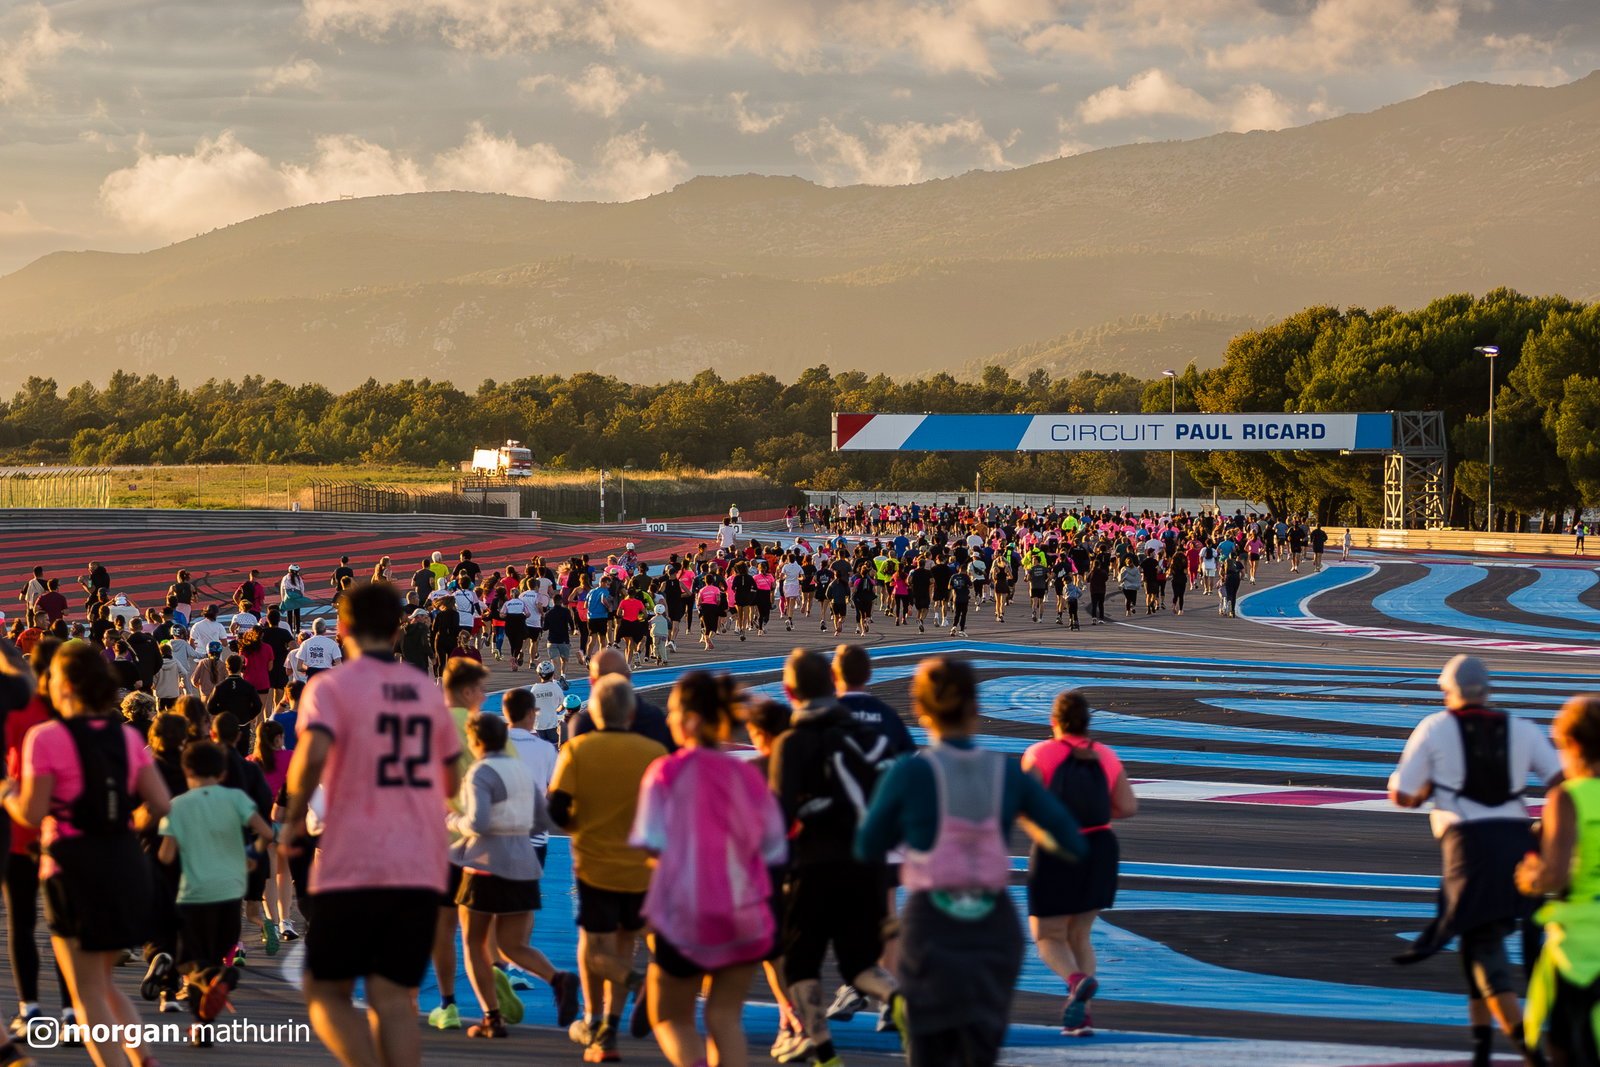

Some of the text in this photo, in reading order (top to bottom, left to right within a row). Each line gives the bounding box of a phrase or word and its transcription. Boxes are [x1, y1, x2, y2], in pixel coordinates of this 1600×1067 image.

[1051, 423, 1326, 441] CIRCUIT PAUL RICARD
[649, 524, 665, 533] 100
[377, 711, 433, 788] 22
